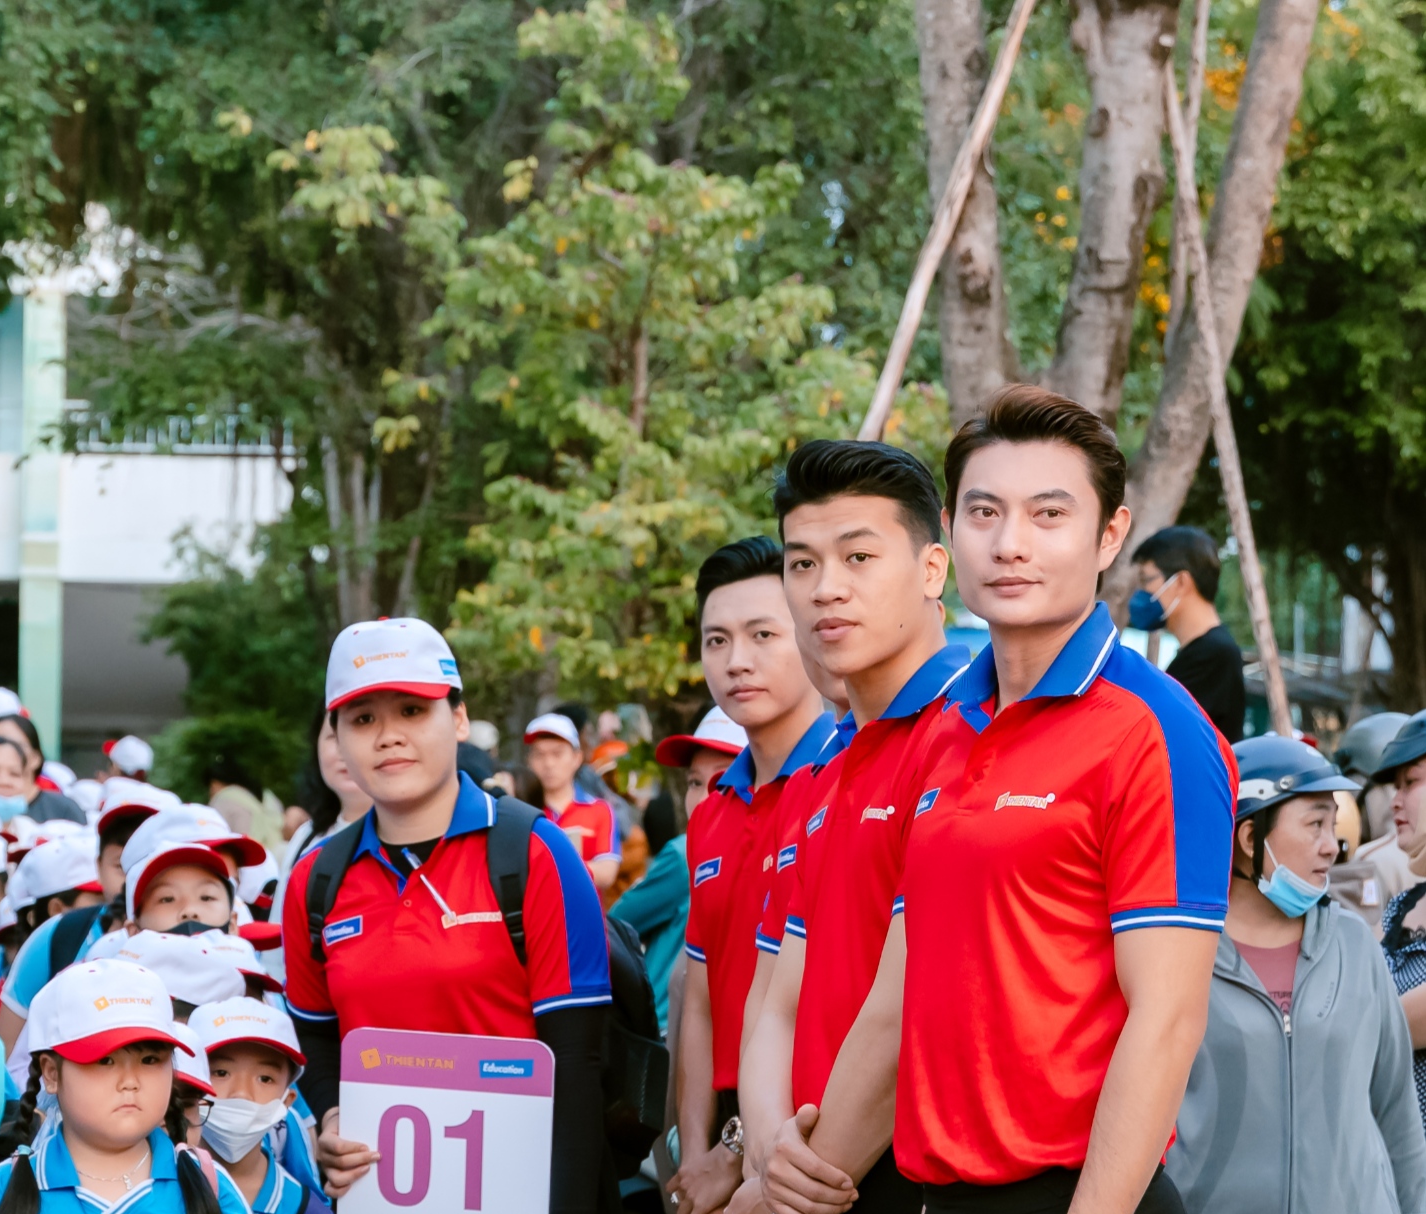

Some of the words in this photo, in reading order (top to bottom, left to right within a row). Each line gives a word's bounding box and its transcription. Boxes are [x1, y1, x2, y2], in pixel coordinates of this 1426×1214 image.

[1007, 796, 1047, 809] THIENTAN
[109, 996, 152, 1006] THIENTAN
[224, 1015, 268, 1025] THIENTAN
[384, 1054, 454, 1070] THIENTAN
[482, 1062, 525, 1075] Education
[376, 1104, 484, 1211] 01
